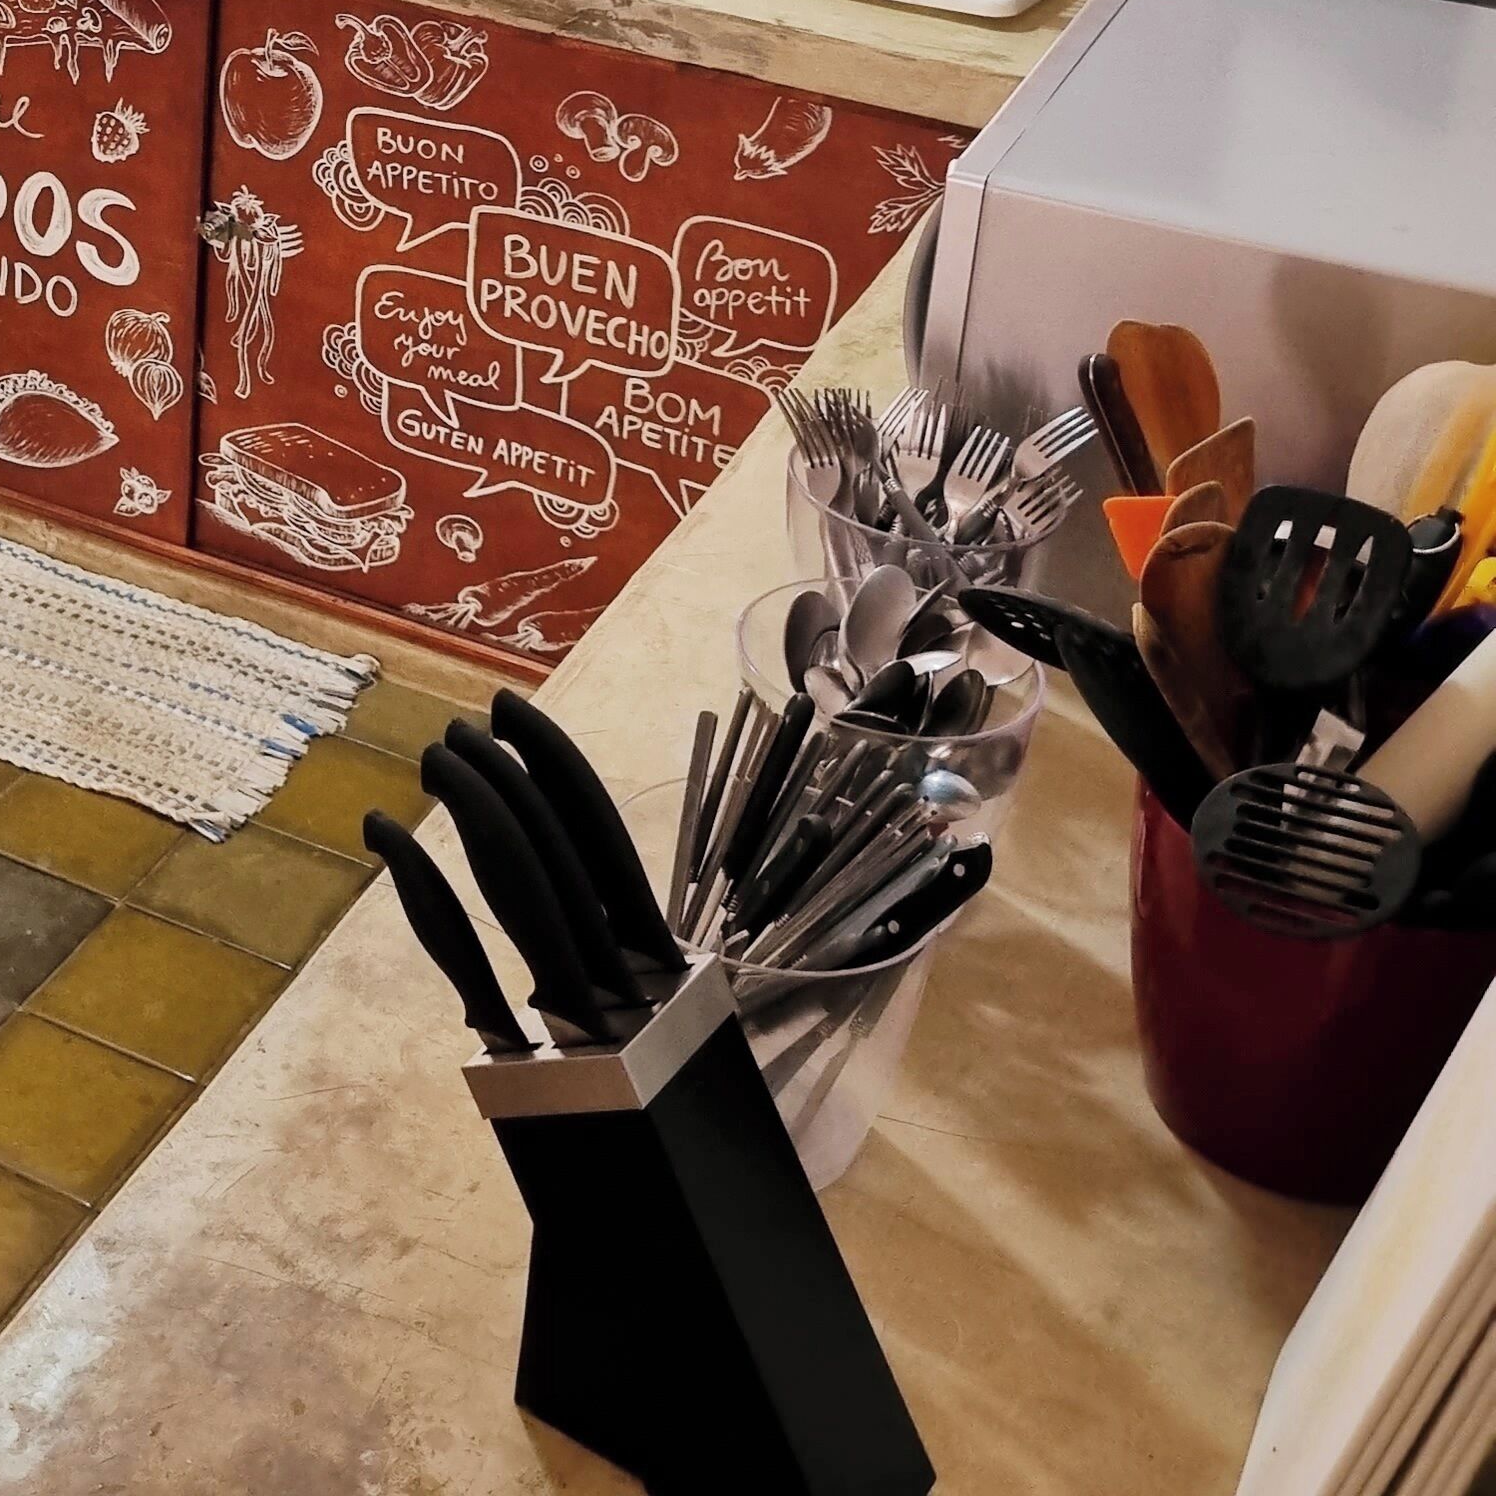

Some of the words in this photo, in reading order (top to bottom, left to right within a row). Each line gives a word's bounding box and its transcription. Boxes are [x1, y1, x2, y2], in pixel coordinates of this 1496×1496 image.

[375, 127, 465, 164] BUON
[503, 233, 638, 309] BUEN
[695, 238, 791, 283] Bon
[374, 291, 469, 345] Enjoy
[480, 277, 671, 360] PROVECHO
[693, 285, 812, 322] appetit
[393, 333, 460, 367] your
[427, 361, 501, 392] meal
[623, 378, 723, 436] BOM
[396, 408, 484, 456] GUTEN
